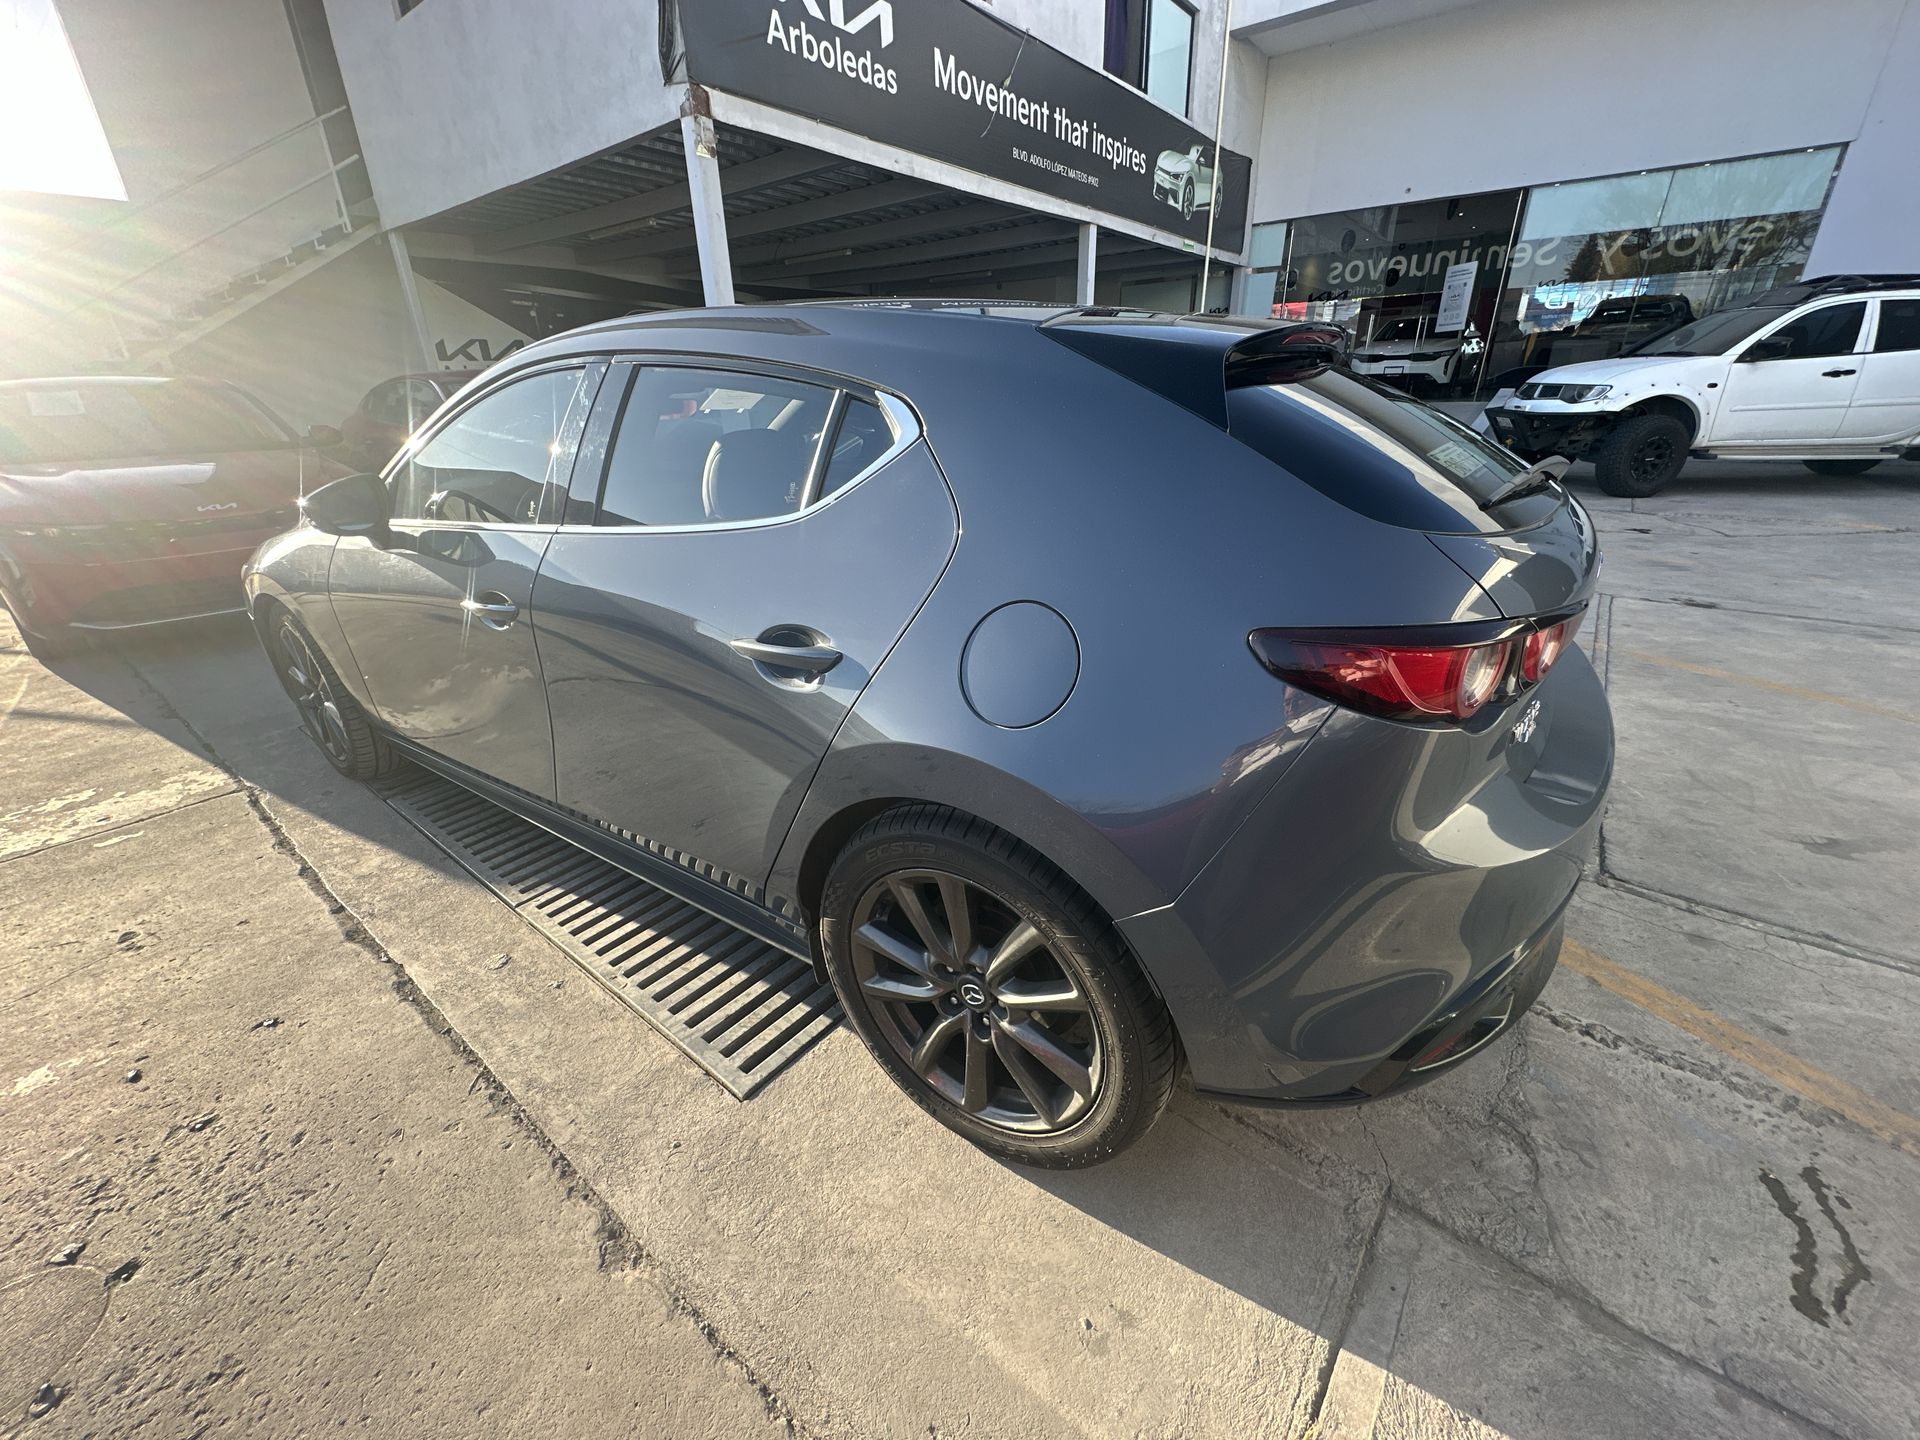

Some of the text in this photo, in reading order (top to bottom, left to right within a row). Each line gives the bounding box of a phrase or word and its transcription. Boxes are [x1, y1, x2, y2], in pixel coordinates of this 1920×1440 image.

[766, 8, 898, 94] Arboledas
[933, 47, 1147, 175] Movement that inspires
[1012, 146, 1029, 163] BLVD.
[1029, 153, 1051, 171] ADOLFO
[1067, 167, 1088, 184] MATEOS
